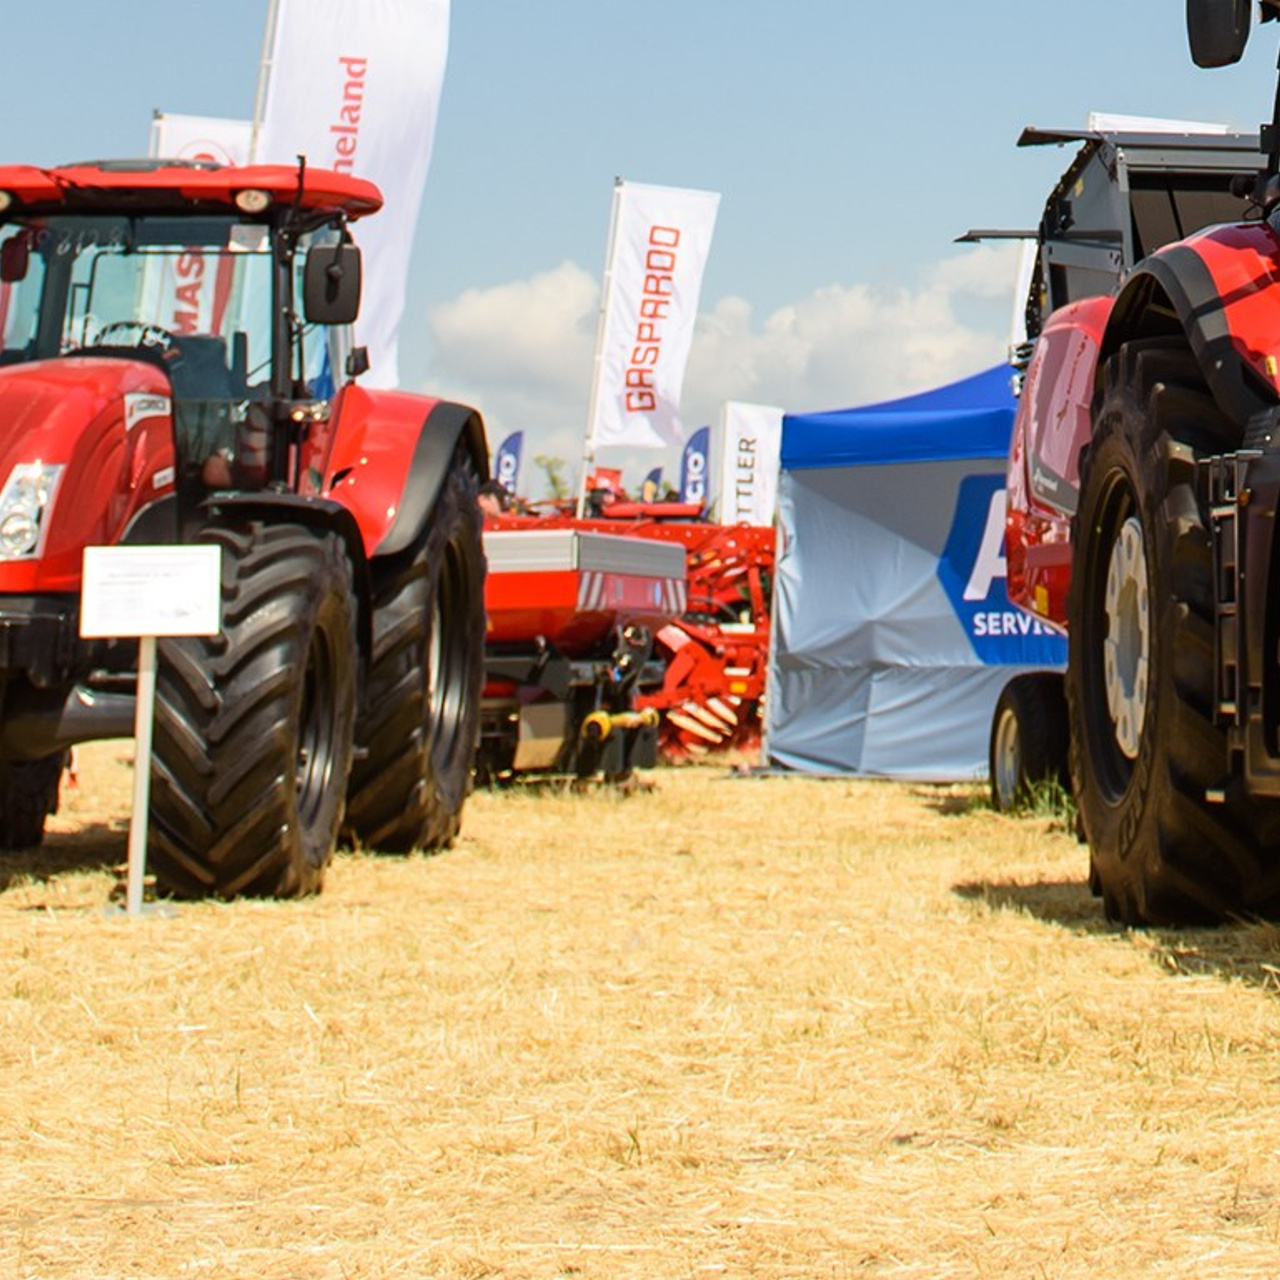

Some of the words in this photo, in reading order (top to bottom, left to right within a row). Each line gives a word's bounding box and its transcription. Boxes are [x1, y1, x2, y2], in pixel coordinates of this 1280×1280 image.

[329, 56, 369, 176] neland
[171, 245, 206, 337] MAS
[623, 224, 681, 413] GASPARDO
